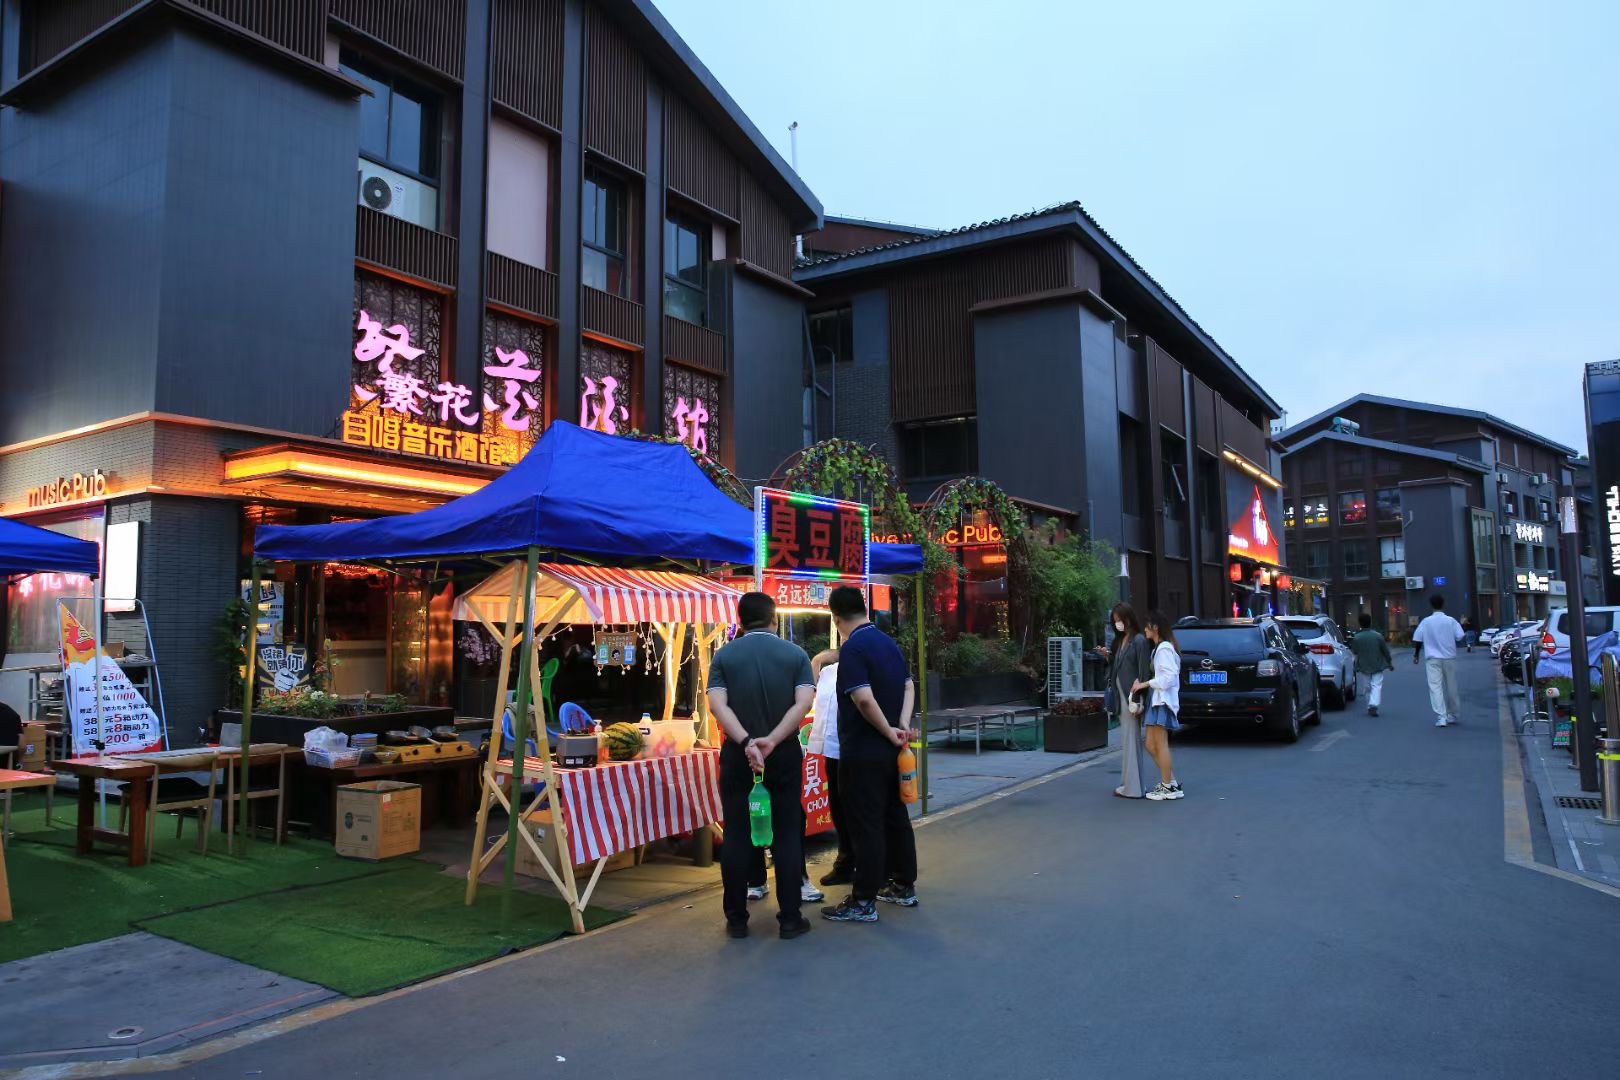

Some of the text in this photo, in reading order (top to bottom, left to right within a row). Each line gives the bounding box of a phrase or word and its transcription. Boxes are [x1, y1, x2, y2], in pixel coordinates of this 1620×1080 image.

[342, 410, 504, 466] 自唱音乐酒馆
[26, 468, 107, 508] music Pub
[767, 499, 865, 574] 臭豆腐
[963, 523, 1002, 543] Pub
